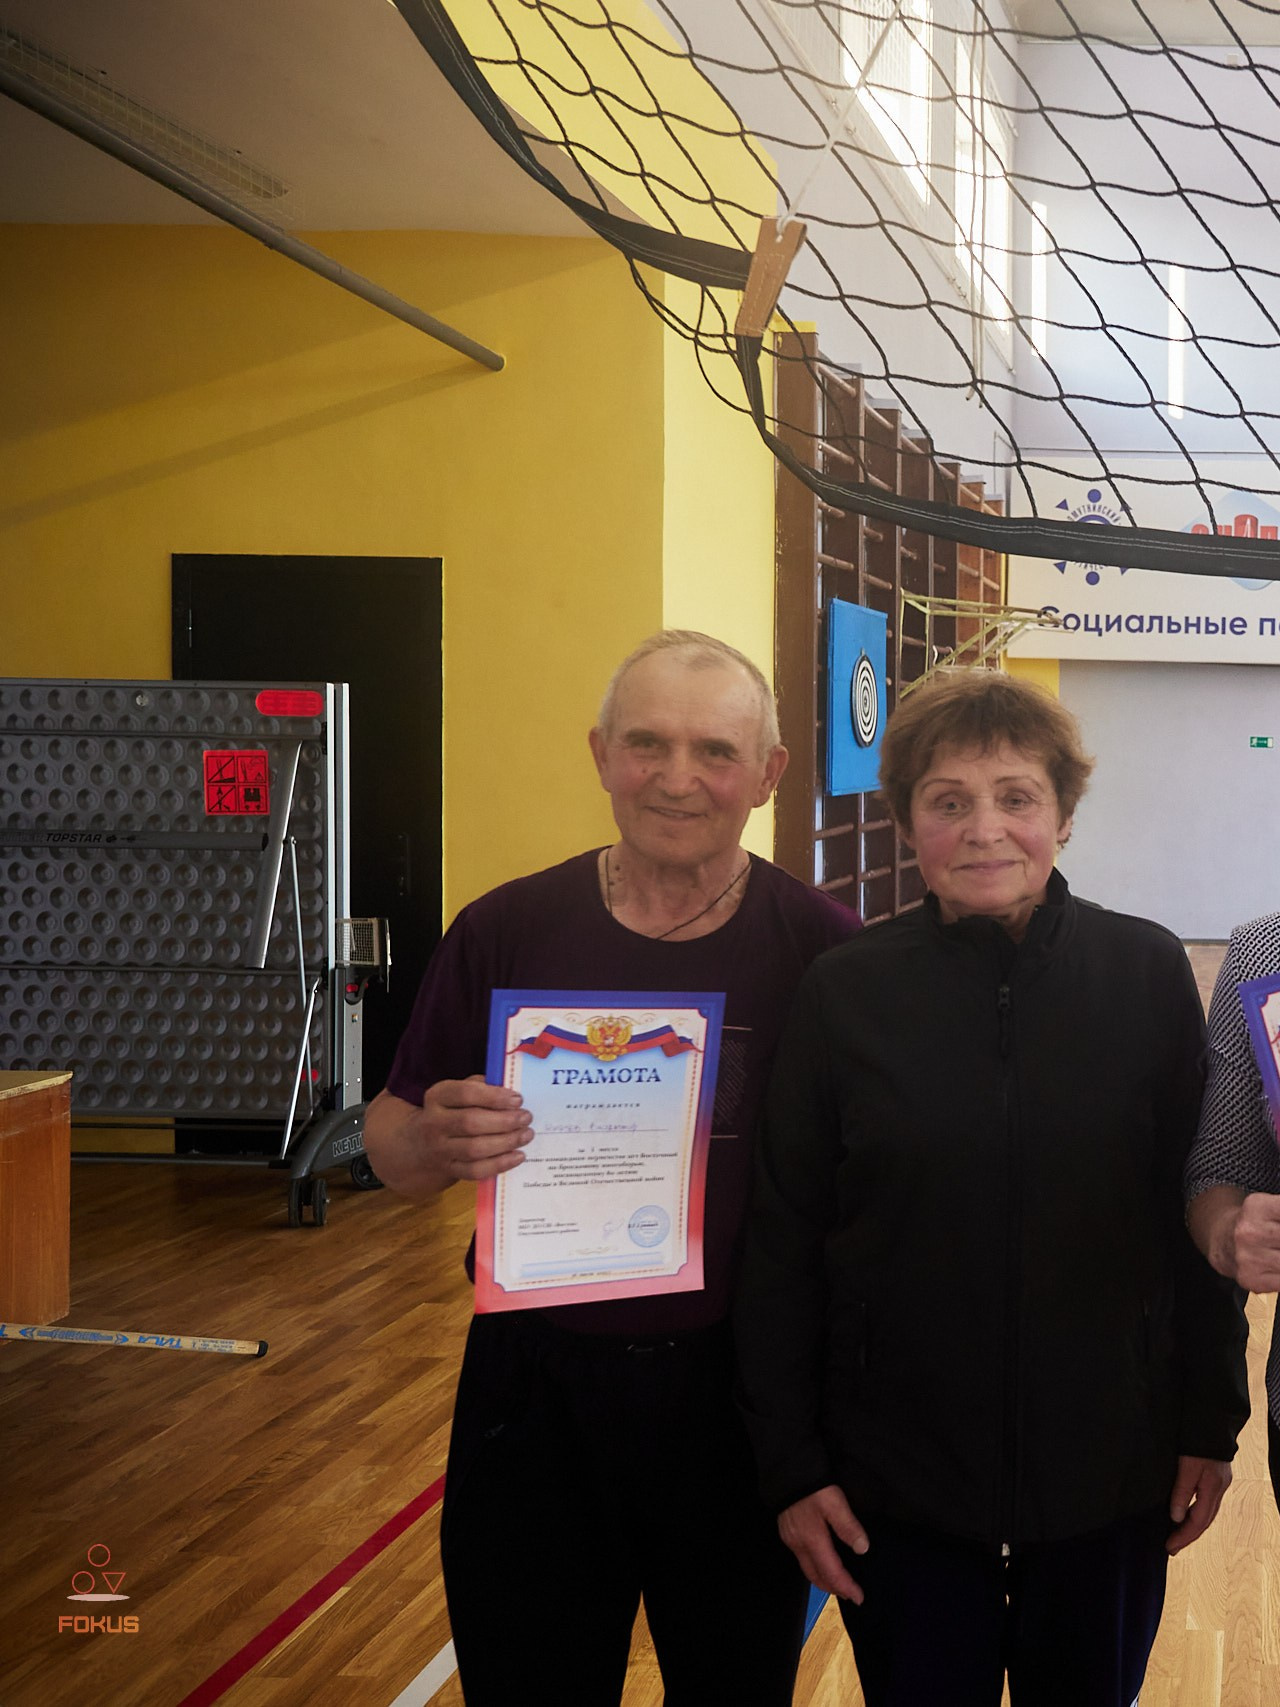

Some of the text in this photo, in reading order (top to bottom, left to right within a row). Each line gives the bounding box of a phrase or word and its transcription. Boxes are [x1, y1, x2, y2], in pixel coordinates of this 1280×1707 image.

[1039, 604, 1247, 637] Социальные
[46, 832, 102, 843] TOPSTAR
[551, 1067, 662, 1085] ГРАМОТА
